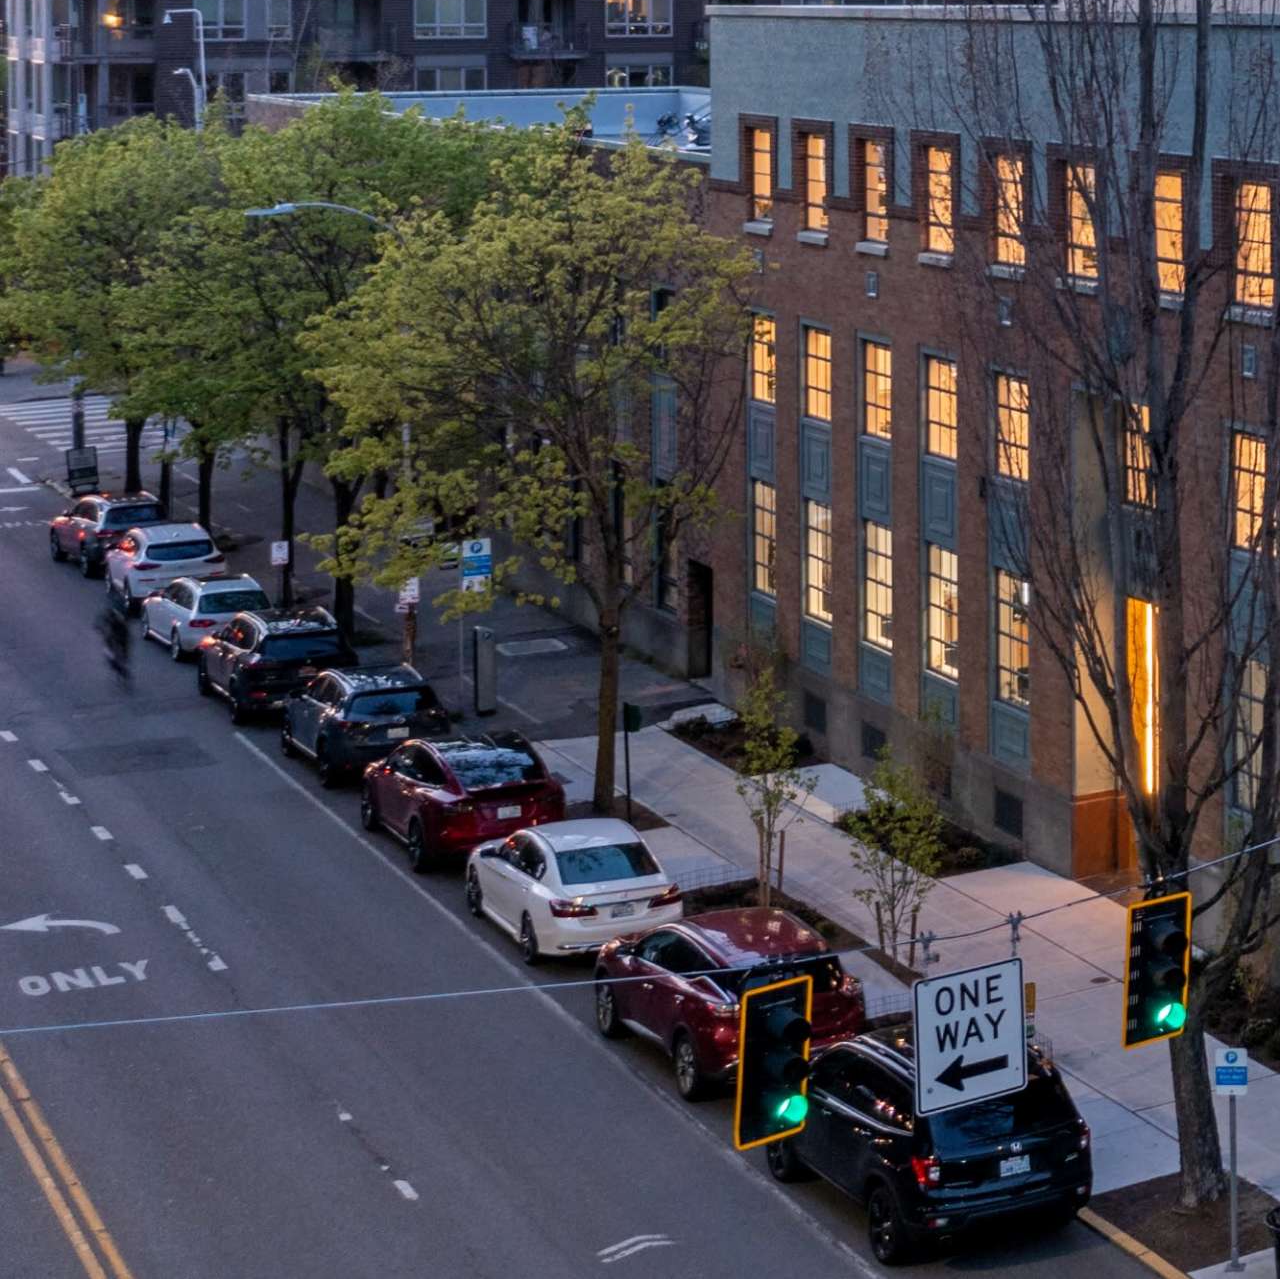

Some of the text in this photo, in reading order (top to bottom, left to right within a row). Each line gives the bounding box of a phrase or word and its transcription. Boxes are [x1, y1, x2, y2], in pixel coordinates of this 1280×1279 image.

[18, 959, 149, 996] ONLY
[935, 974, 1004, 1016] ONE
[935, 1009, 1007, 1053] WAY
